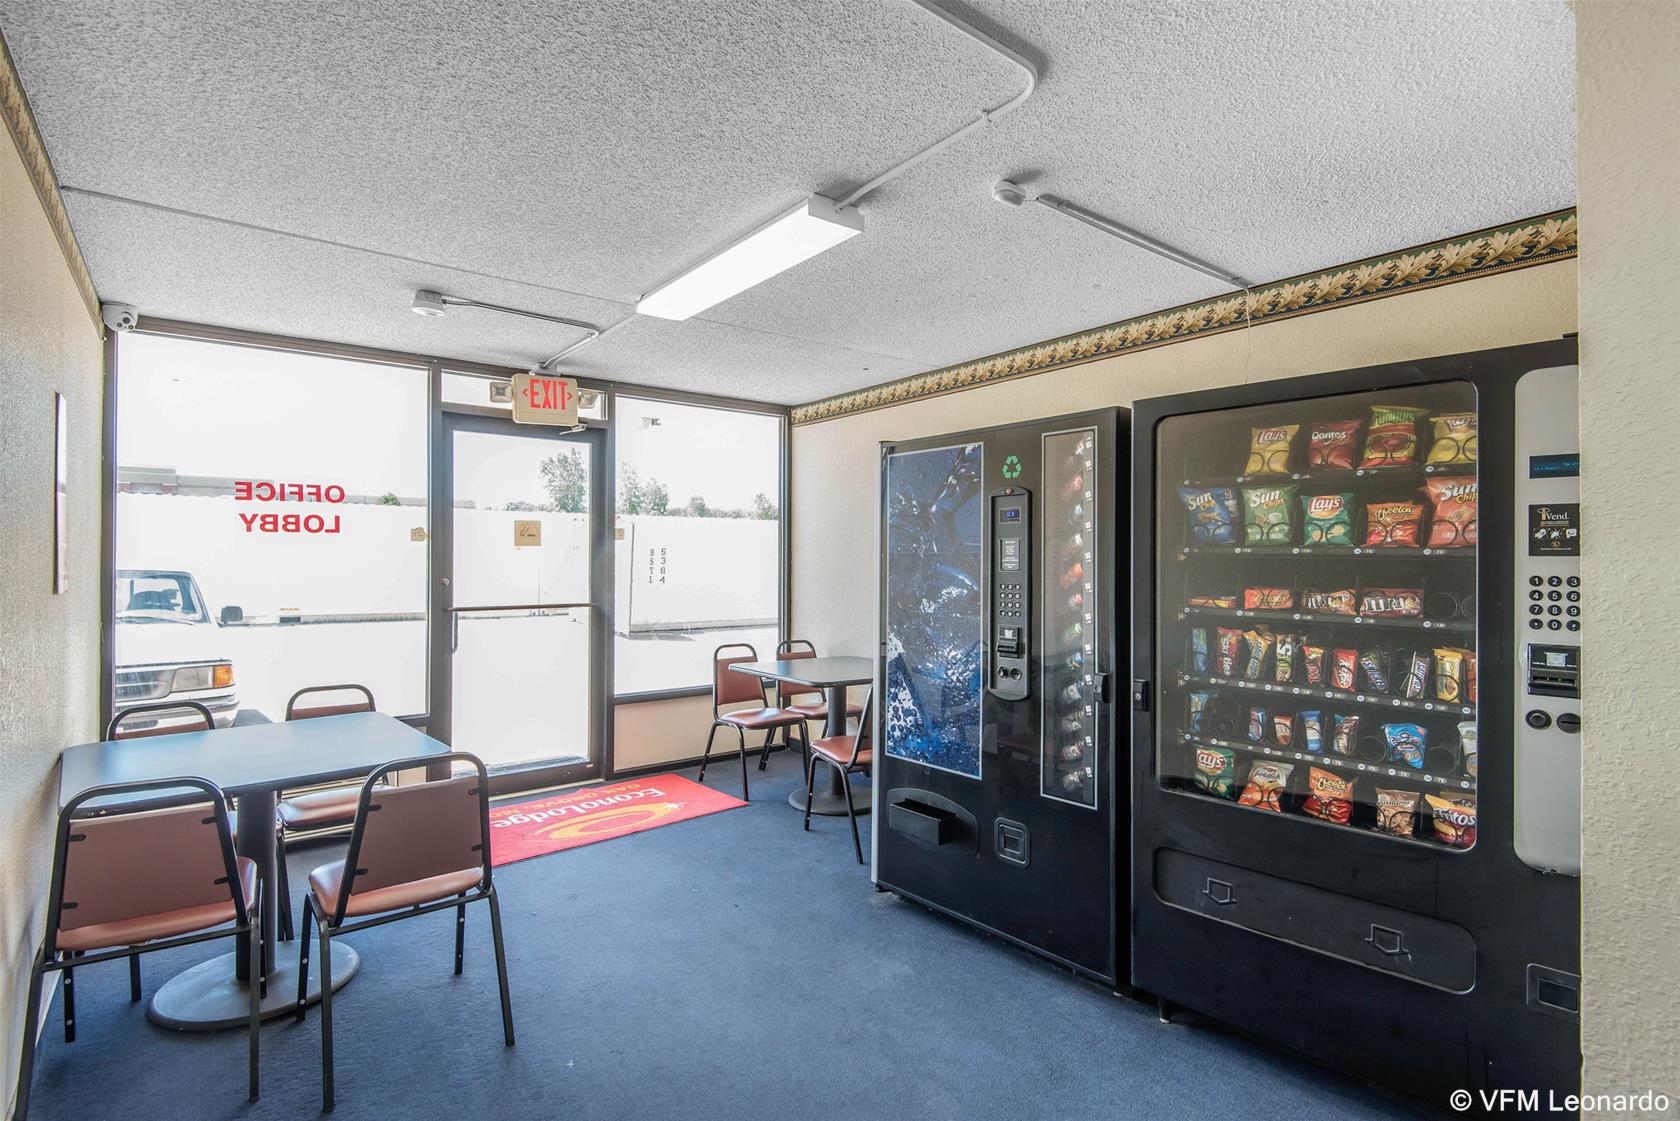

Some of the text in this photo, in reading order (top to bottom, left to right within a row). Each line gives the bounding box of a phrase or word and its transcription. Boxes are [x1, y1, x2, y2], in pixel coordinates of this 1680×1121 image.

[530, 379, 568, 410] EXIT
[1312, 431, 1346, 440] Doritos
[1187, 492, 1212, 511] Sun
[1250, 490, 1280, 507] Sun
[1263, 498, 1285, 510] Chips
[1376, 505, 1415, 521] Cheetos
[603, 783, 640, 794] OAK
